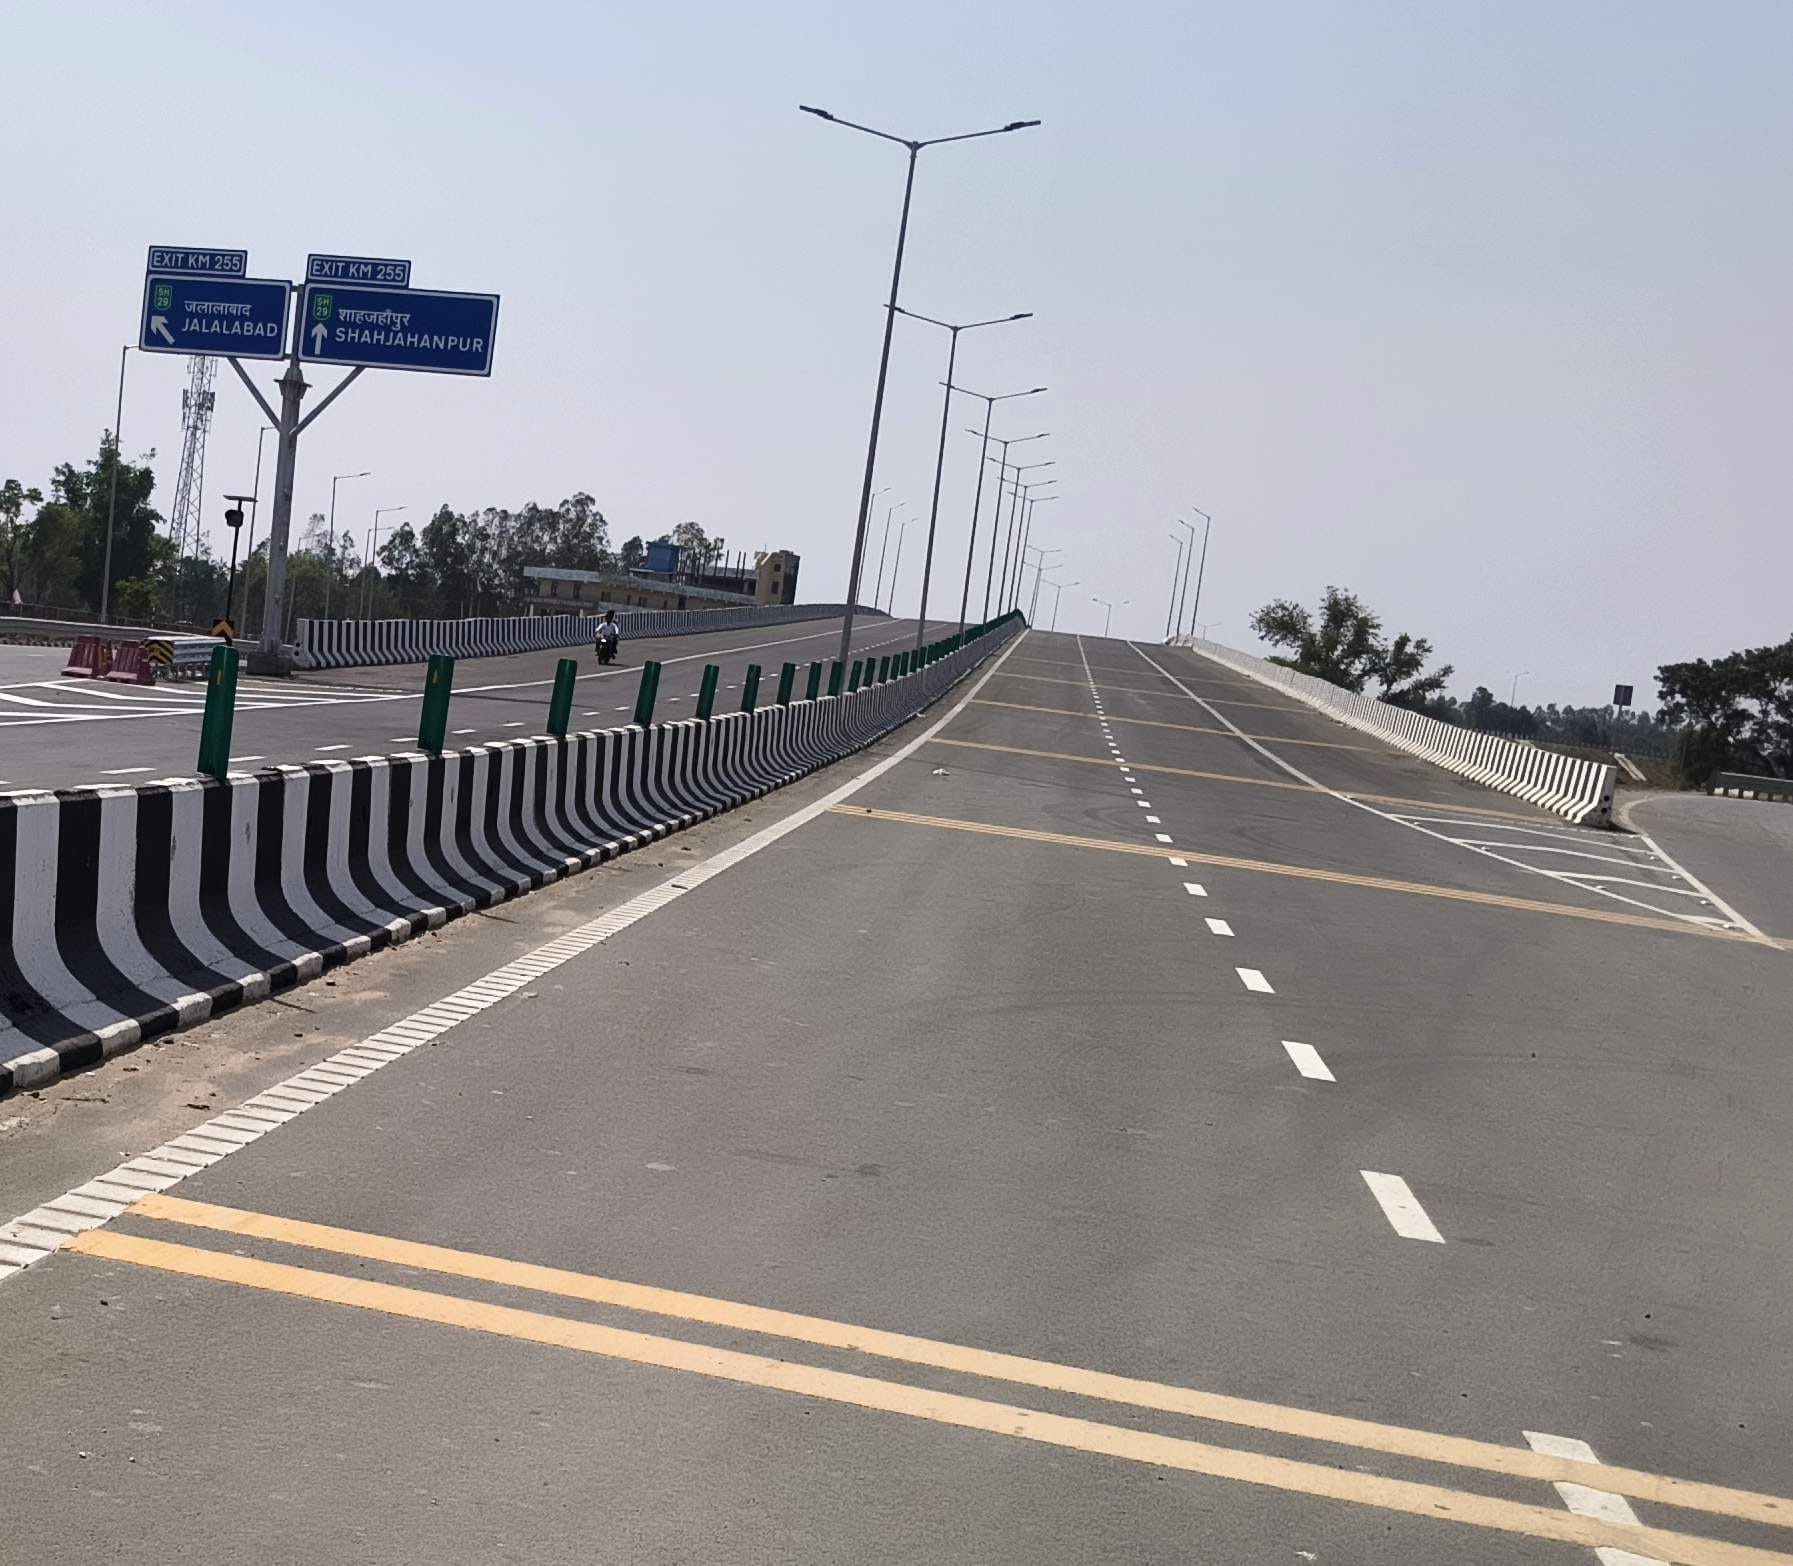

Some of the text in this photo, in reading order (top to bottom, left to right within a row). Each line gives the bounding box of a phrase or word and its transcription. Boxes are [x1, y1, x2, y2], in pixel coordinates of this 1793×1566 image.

[153, 252, 240, 270] EXIT KM 255
[312, 260, 404, 281] EXIT KM 255
[158, 288, 169, 297] SH
[157, 297, 169, 306] 29
[316, 297, 329, 306] SH
[316, 307, 328, 316] 29
[181, 318, 278, 337] JALALABAD
[335, 327, 484, 353] SHAHJAHANPUR
